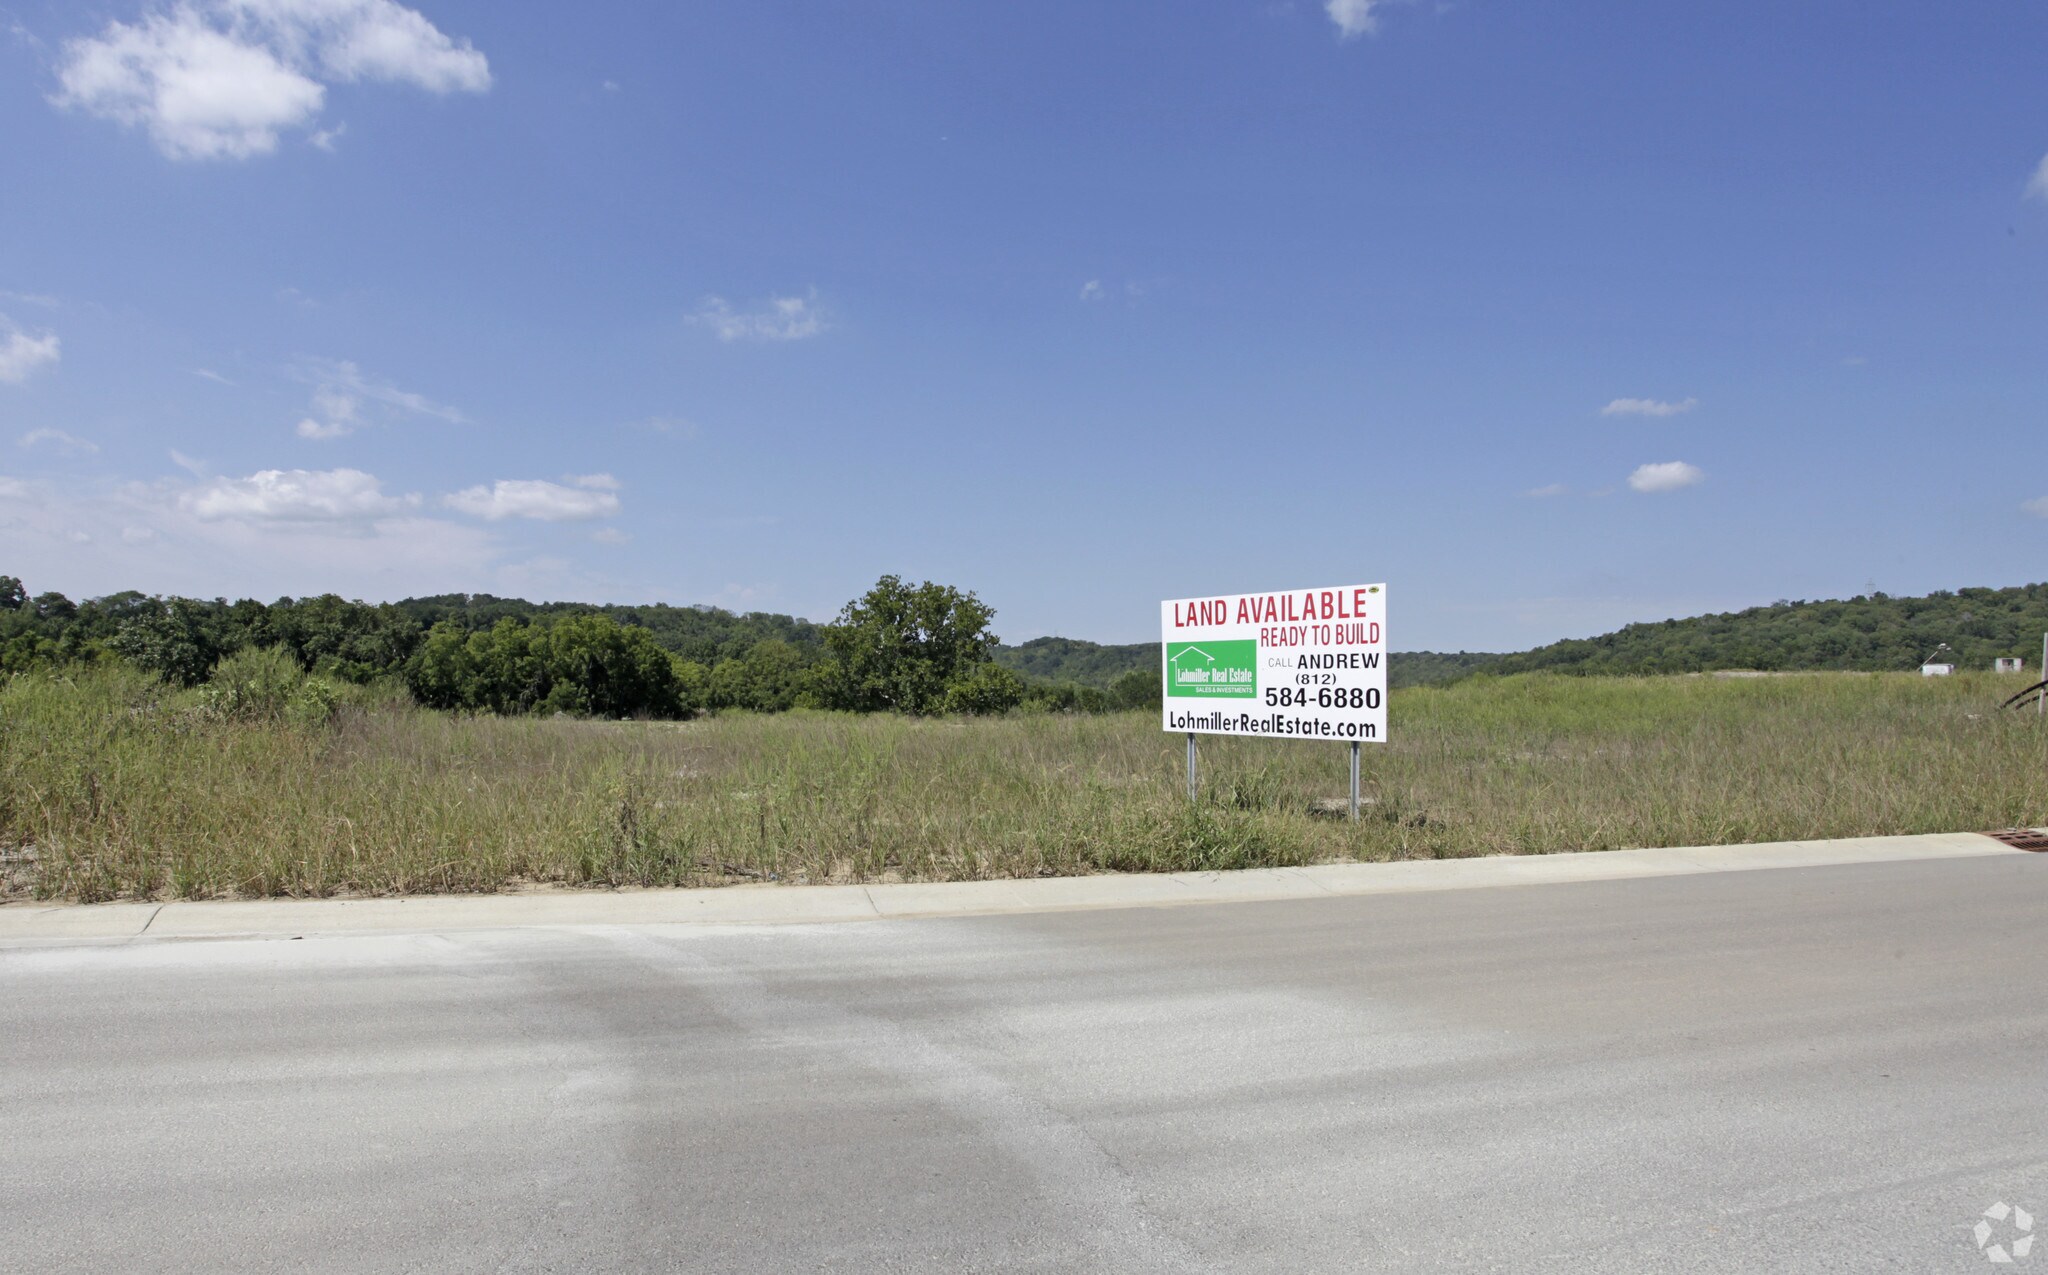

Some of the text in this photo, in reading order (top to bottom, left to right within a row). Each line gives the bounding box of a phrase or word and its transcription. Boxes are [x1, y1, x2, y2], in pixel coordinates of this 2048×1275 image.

[1175, 589, 1366, 627] LAND AVAILABLE
[1261, 622, 1379, 647] READY TO BUILD
[1268, 653, 1379, 669] CALL ANDREW
[1212, 668, 1228, 683] Real
[1229, 668, 1252, 683] Estate
[1296, 673, 1337, 685] (812)
[1265, 688, 1380, 709] 584-6880
[1170, 711, 1376, 738] LohmillerRealEstate.com
